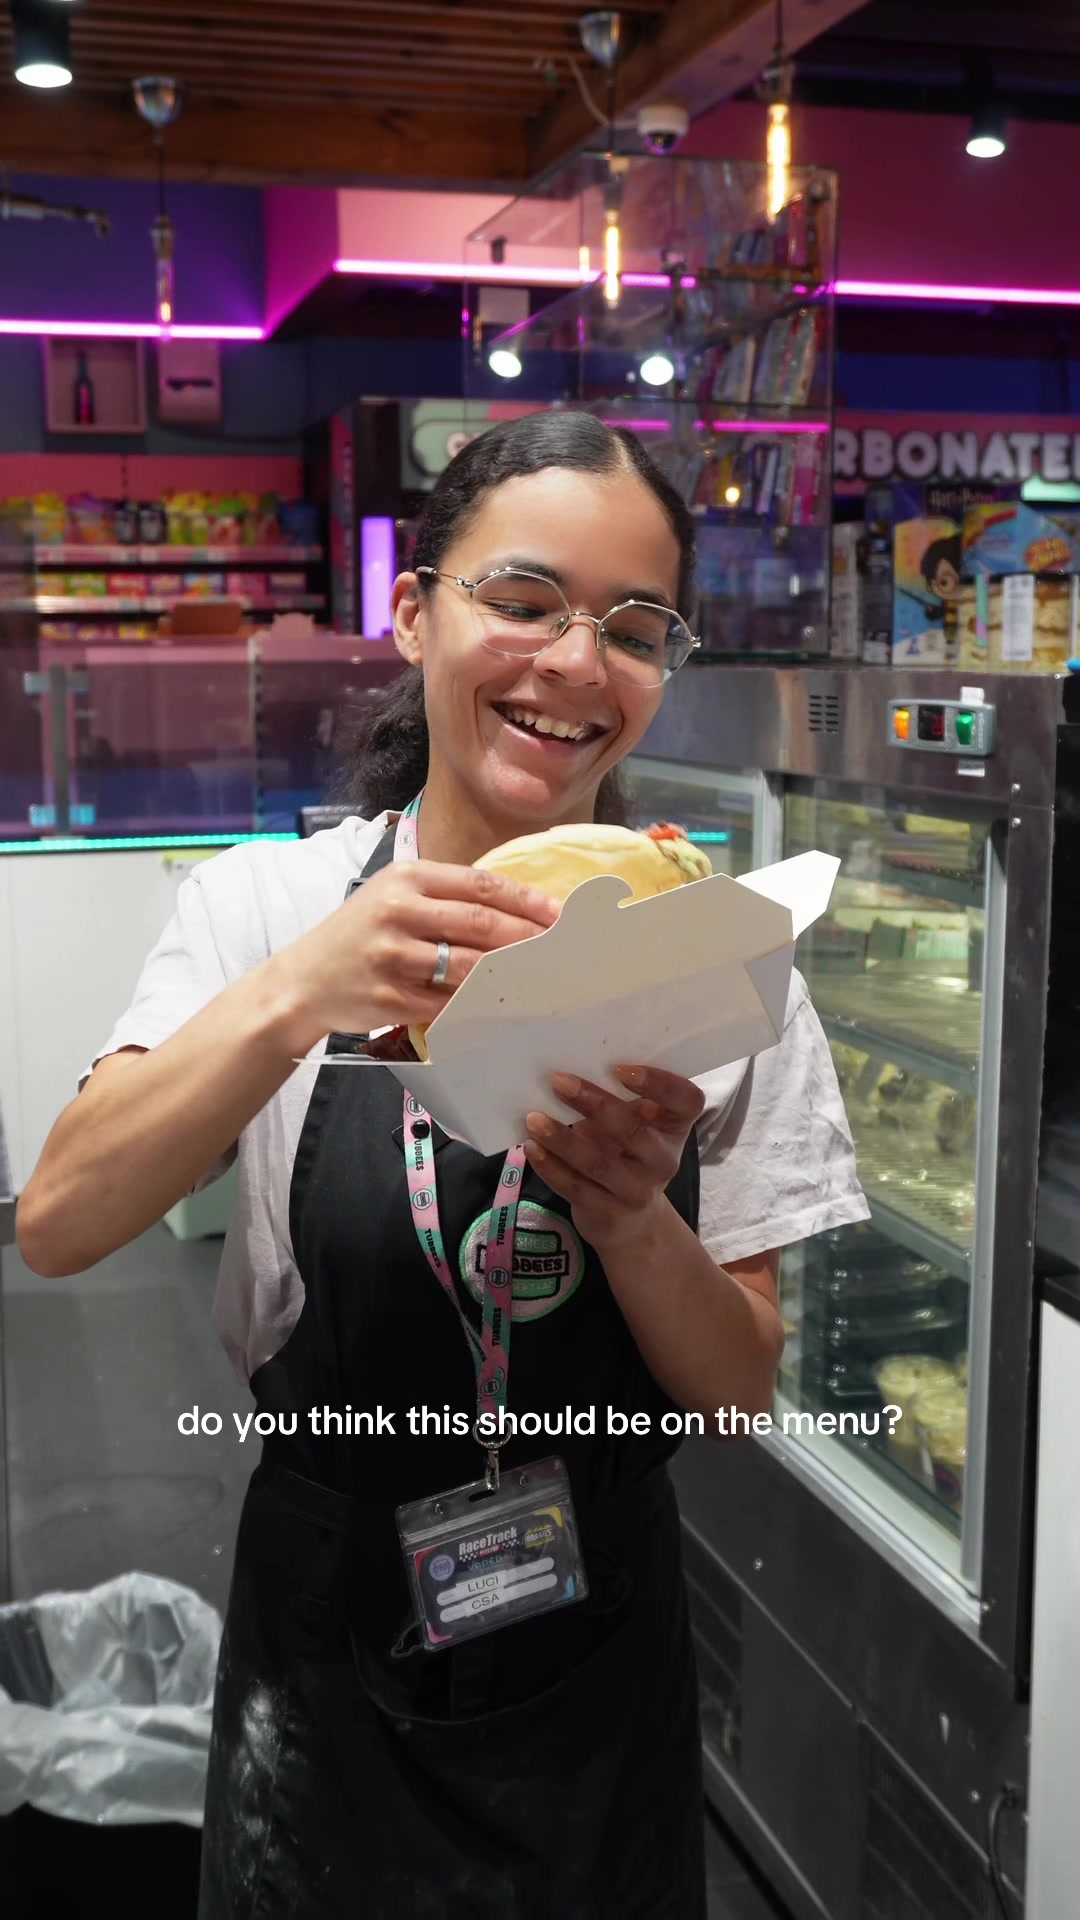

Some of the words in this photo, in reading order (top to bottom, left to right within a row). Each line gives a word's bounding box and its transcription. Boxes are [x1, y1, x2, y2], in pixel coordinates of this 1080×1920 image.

[832, 428, 1080, 481] RBONATE
[414, 1136, 424, 1171] UBBEES
[496, 1206, 509, 1246] TUBBEES
[424, 1228, 442, 1268] TUBBEES
[516, 1236, 556, 1249] SHEES
[512, 1257, 563, 1273] BBEES
[459, 1526, 518, 1556] RaceTrack
[467, 1575, 499, 1593] LUCI
[471, 1593, 500, 1610] CSA
